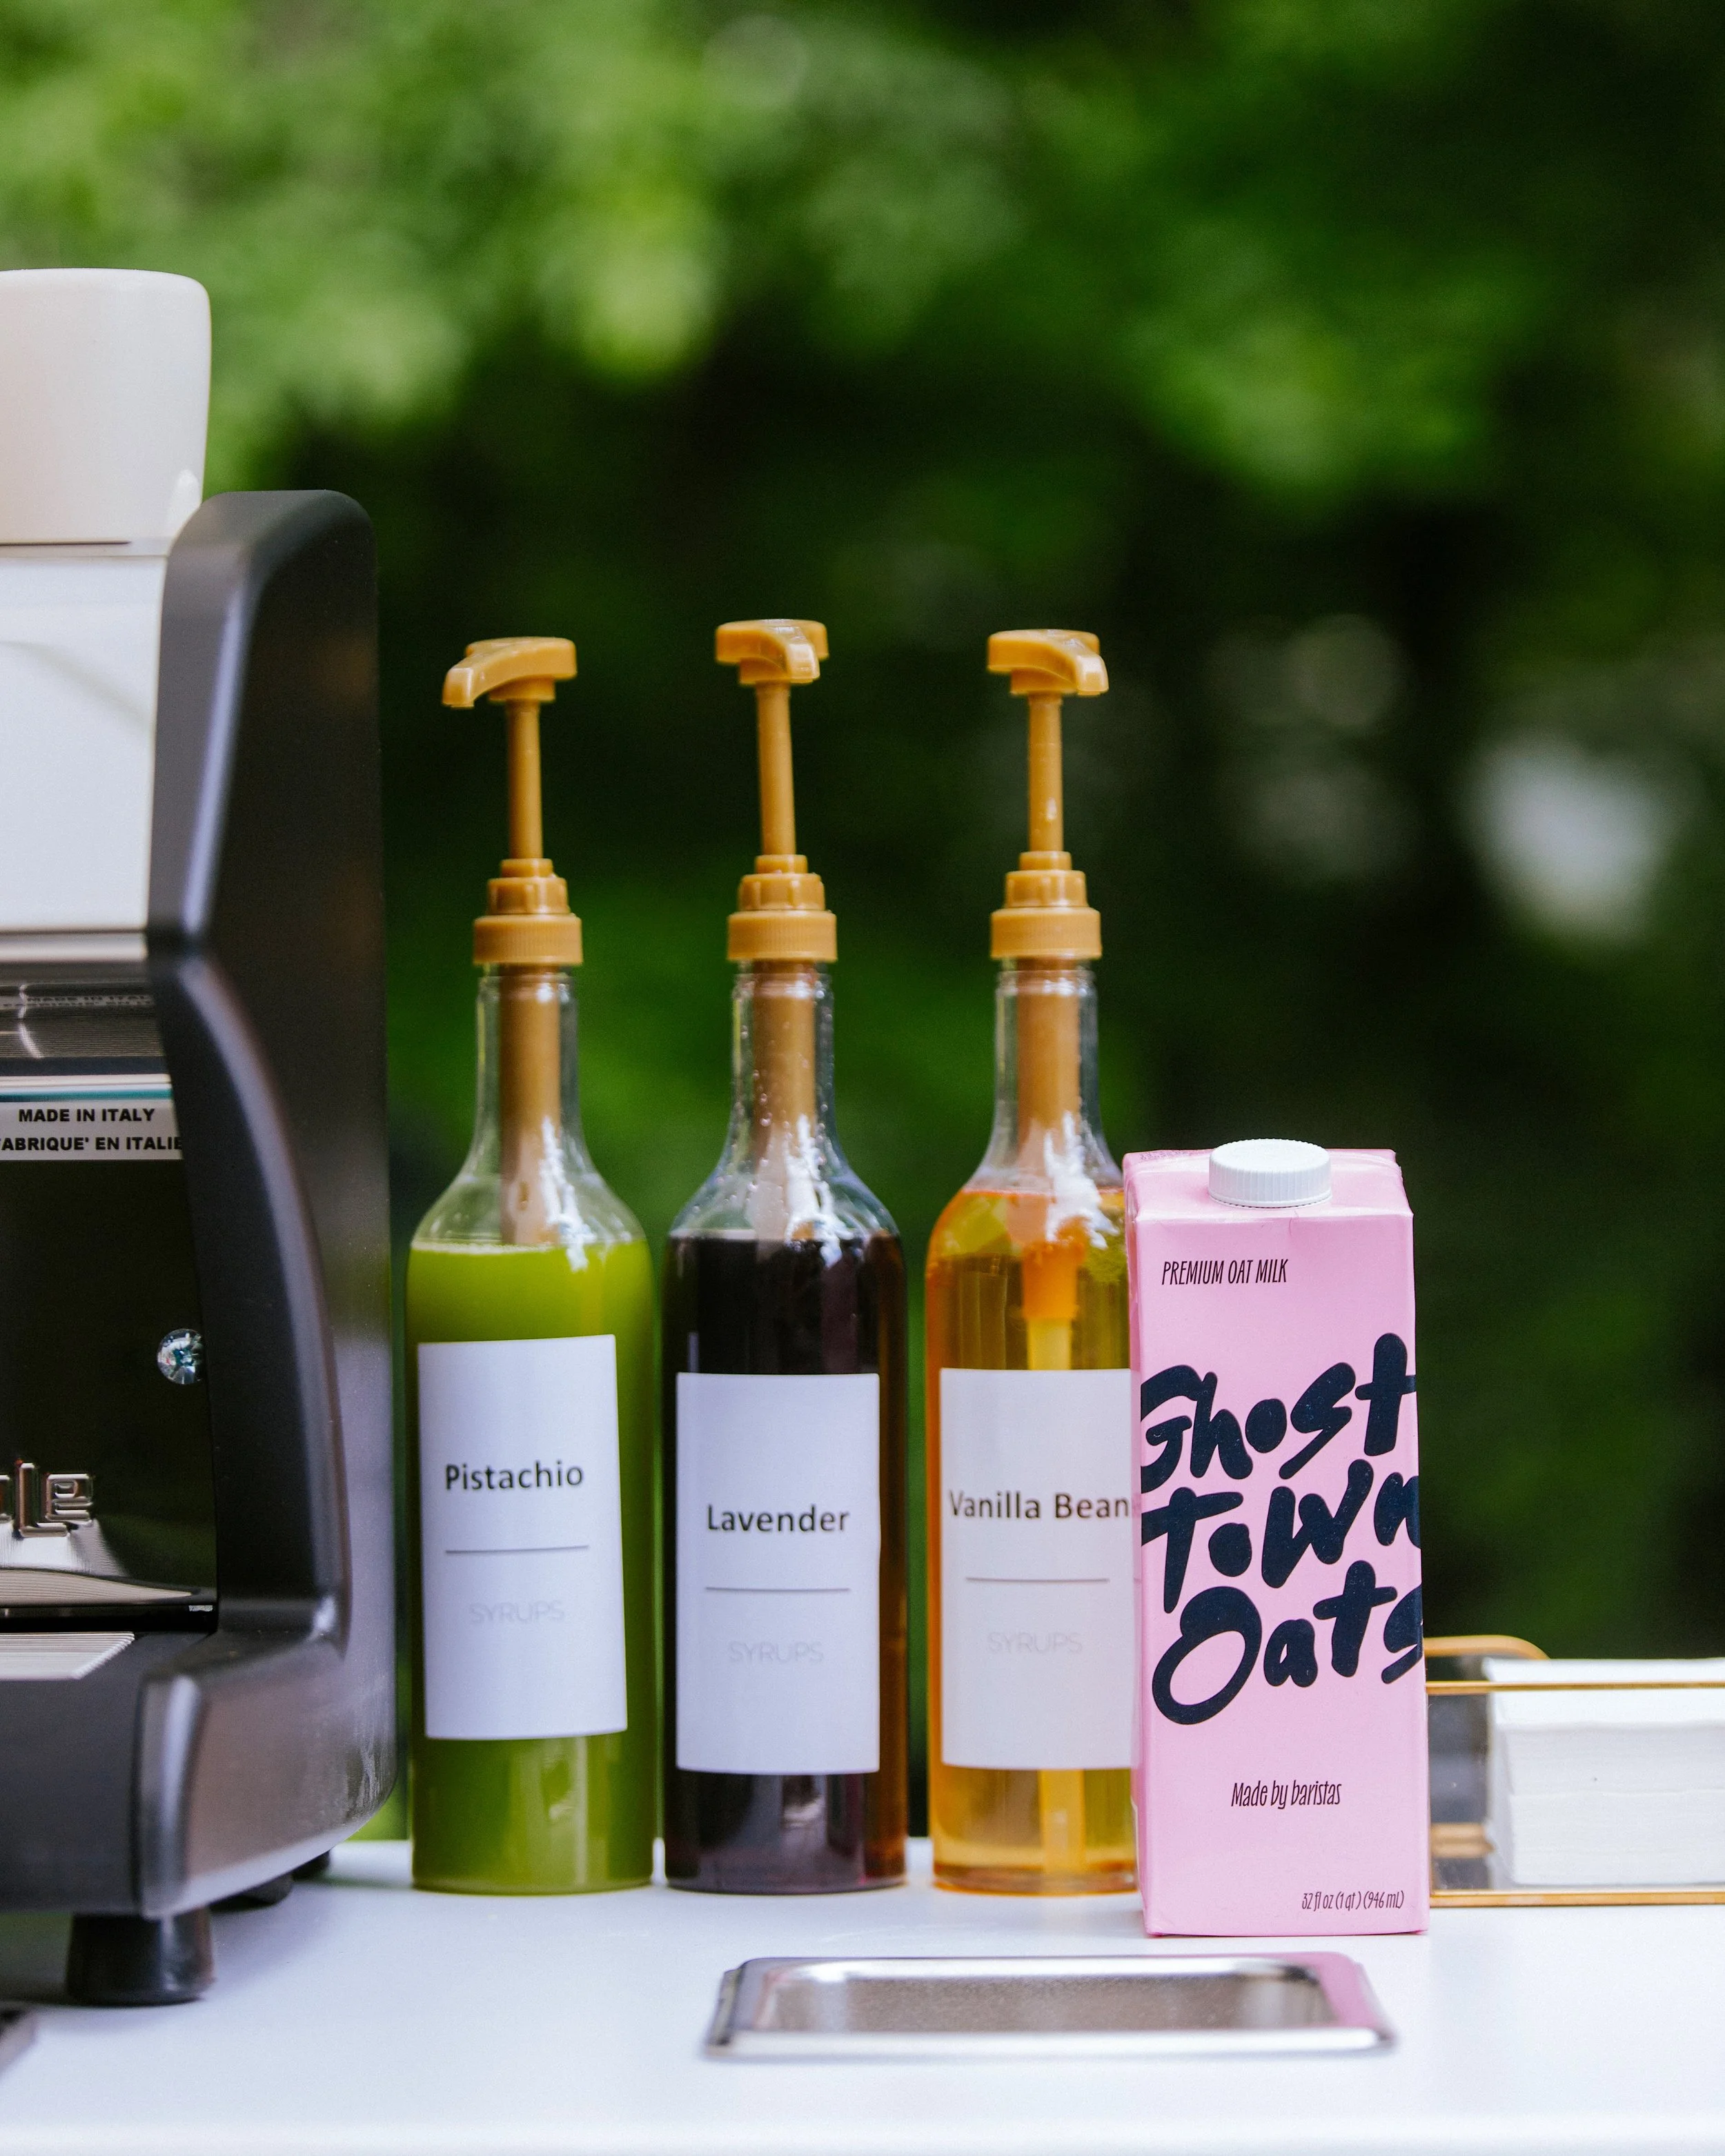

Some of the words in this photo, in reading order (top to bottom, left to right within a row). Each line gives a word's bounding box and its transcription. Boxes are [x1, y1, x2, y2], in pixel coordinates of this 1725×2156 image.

[19, 1109, 70, 1122] MADE
[77, 1109, 95, 1122] IN
[101, 1108, 155, 1122] ITALY
[0, 1137, 89, 1151] ABRIQUE'
[95, 1136, 119, 1150] EN
[126, 1136, 183, 1150] ITALIE
[1161, 1260, 1225, 1285] PREMIUM
[1228, 1260, 1254, 1284] OAT
[1255, 1258, 1289, 1283] MILK
[1141, 1332, 1417, 1494] Ghost
[445, 1460, 585, 1491] Pistachio
[707, 1503, 849, 1533] Lavender
[949, 1490, 1041, 1519] Vanilla
[1054, 1492, 1130, 1519] Bean
[469, 1600, 565, 1625] SYRUPS
[729, 1640, 825, 1664] SYRUPS
[987, 1631, 1083, 1656] SYRUPS
[1152, 1559, 1423, 1725] Oats
[1231, 1780, 1268, 1807] Made
[1270, 1780, 1289, 1810] by
[1290, 1779, 1343, 1806] baristas
[1301, 1892, 1313, 1910] 32
[1313, 1891, 1322, 1912] fl
[1323, 1895, 1334, 1910] oz
[1363, 1890, 1386, 1910] (946
[1386, 1890, 1405, 1910] mL)
